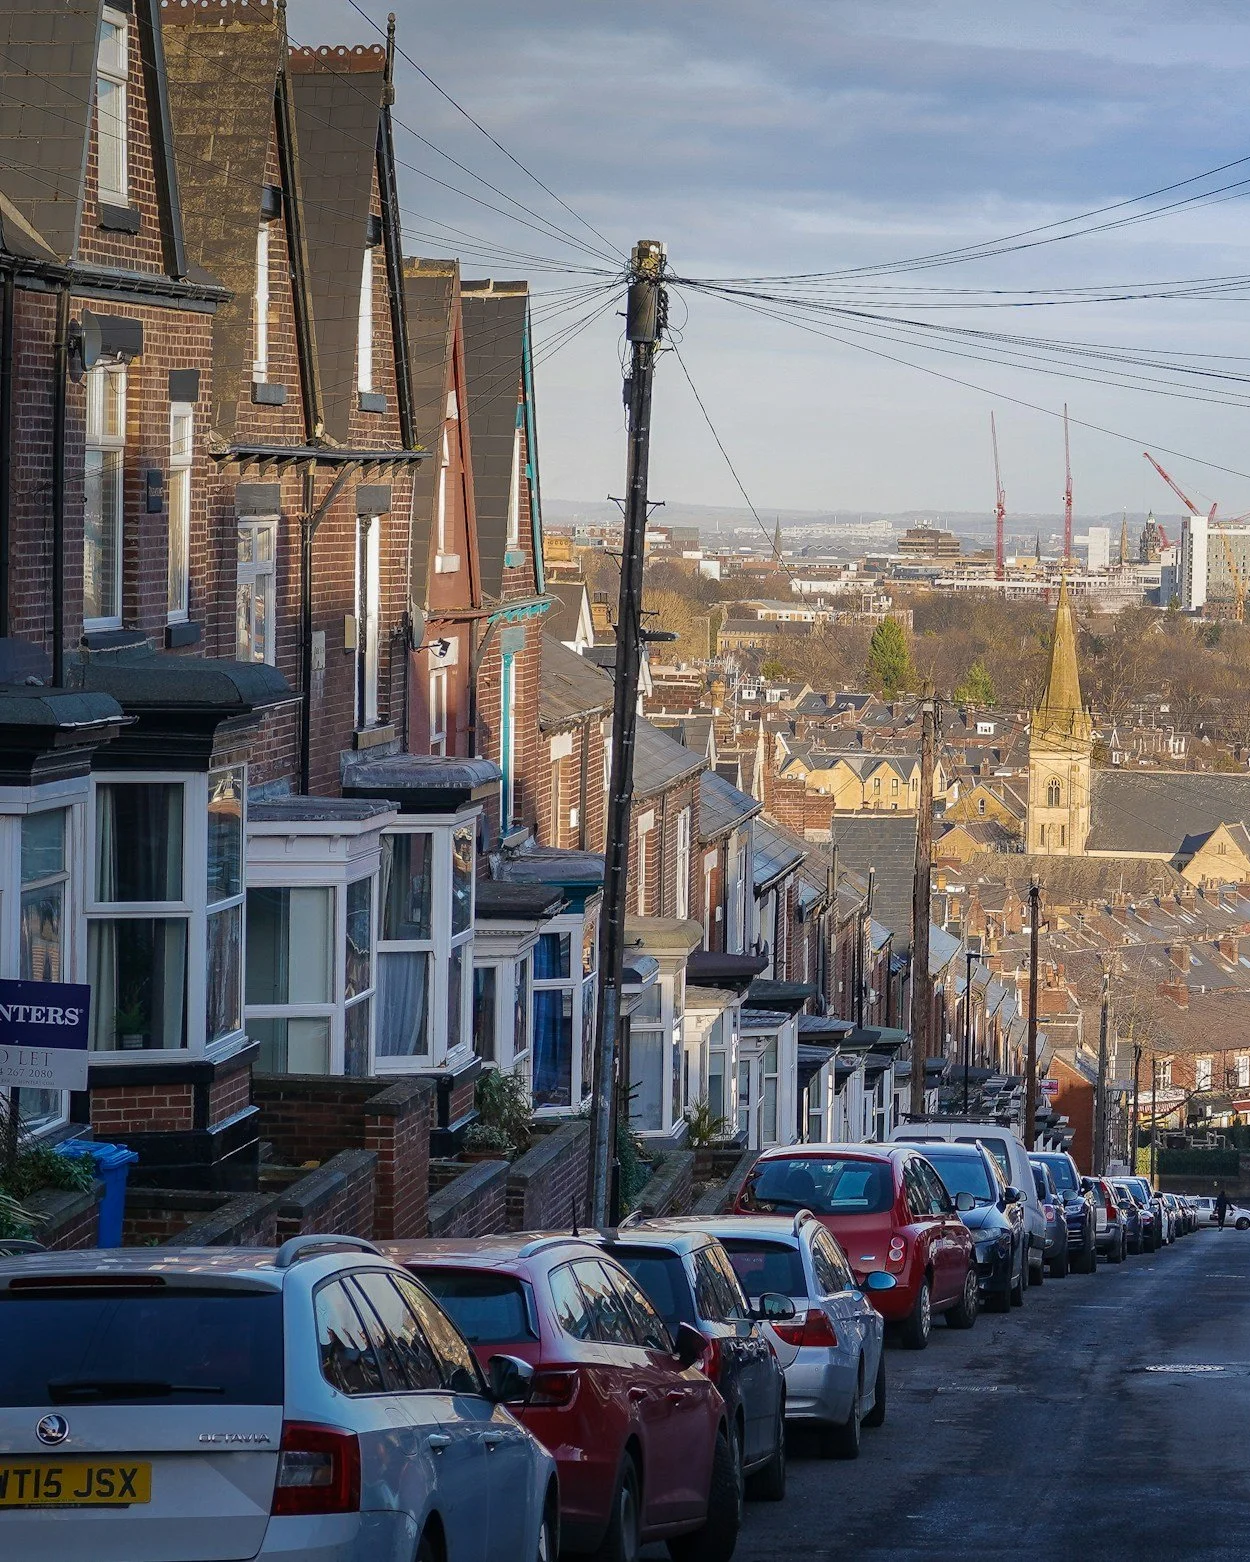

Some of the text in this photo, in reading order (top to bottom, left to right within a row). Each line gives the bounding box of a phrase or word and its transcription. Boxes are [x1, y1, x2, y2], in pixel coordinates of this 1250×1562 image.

[19, 1050, 53, 1067] LET
[7, 1067, 25, 1077] 267
[29, 1069, 53, 1079] 2080
[198, 1432, 271, 1444] OCTAVIA
[73, 1468, 138, 1498] JSX
